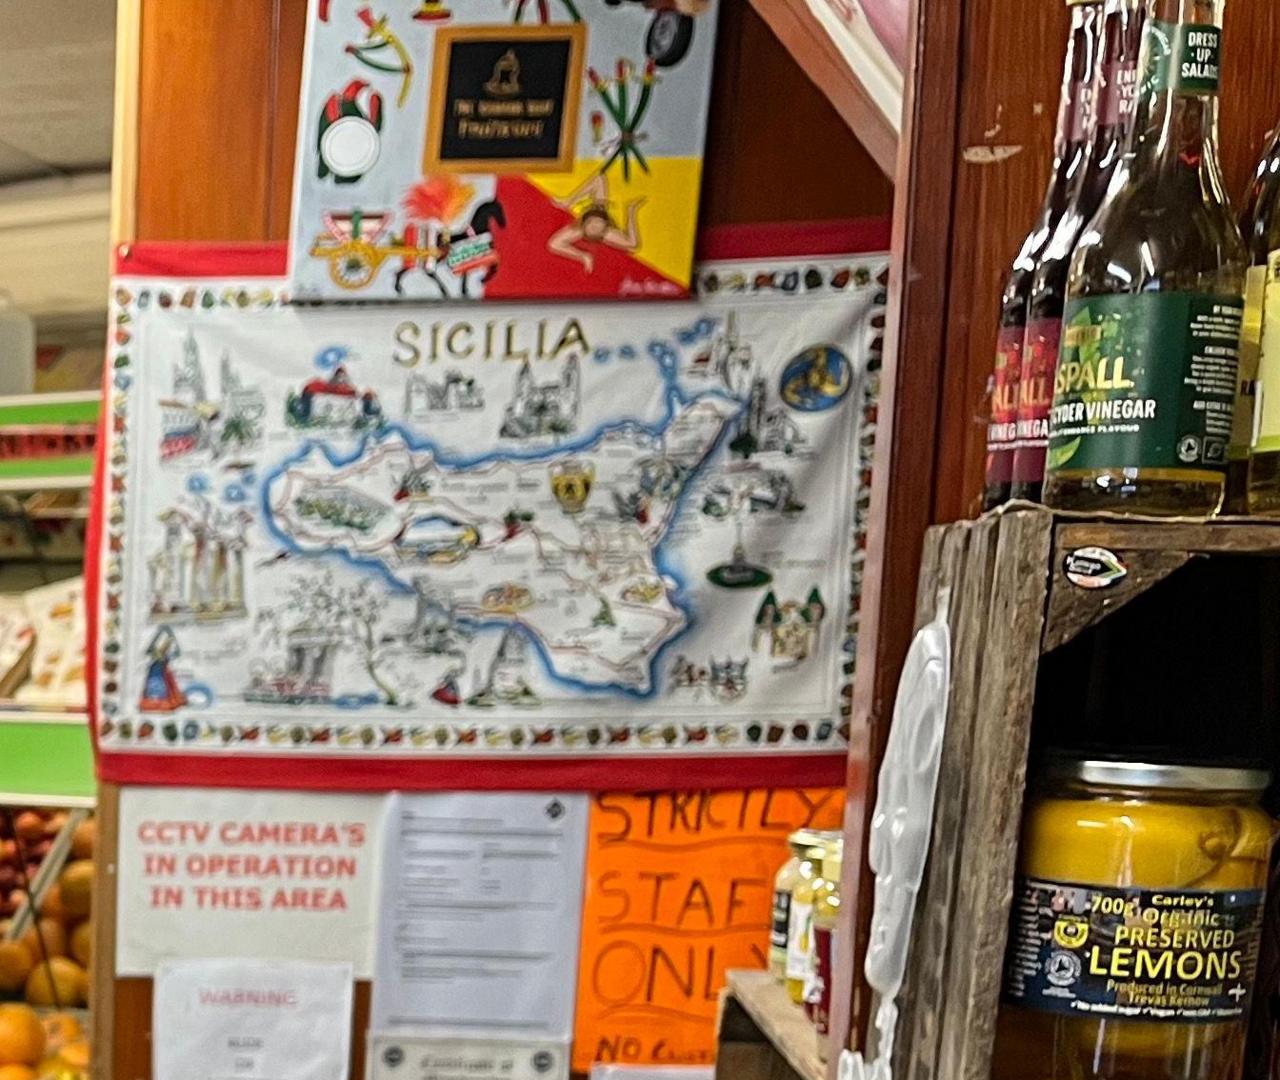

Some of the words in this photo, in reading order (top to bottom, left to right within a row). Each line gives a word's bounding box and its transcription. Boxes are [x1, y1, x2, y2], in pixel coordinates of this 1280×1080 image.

[1188, 31, 1218, 48] DRESS
[391, 317, 591, 368] SICILIA
[1054, 355, 1135, 395] SPALL
[1085, 399, 1156, 419] VINEGAR
[138, 821, 210, 846] CCTV
[219, 821, 367, 848] CAMERA'S
[143, 854, 177, 876] IN
[185, 854, 357, 880] OPERATION
[150, 886, 184, 908] IN
[193, 887, 263, 910] THIS
[271, 887, 348, 911] AREA
[597, 869, 768, 928] STAF
[1151, 894, 1215, 908] Carley's
[1115, 925, 1235, 949] PRESERVED
[1090, 945, 1242, 980] LEMONS
